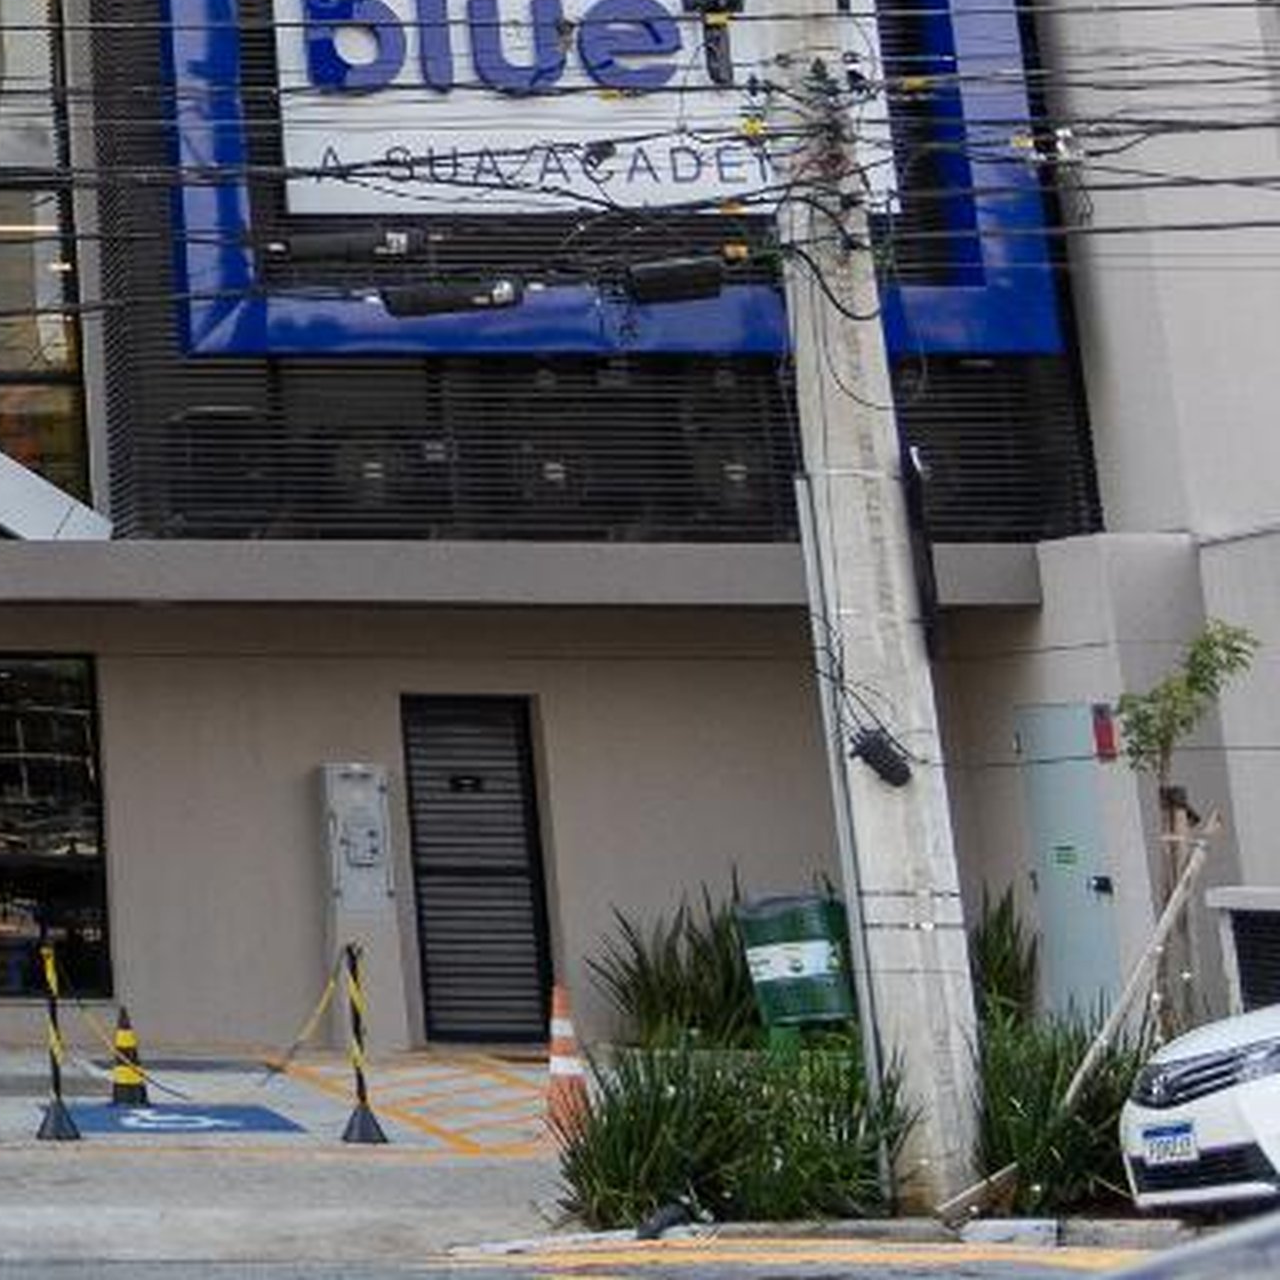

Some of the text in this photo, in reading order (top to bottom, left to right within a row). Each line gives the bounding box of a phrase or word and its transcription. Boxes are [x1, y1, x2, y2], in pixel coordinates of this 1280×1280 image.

[316, 144, 792, 187] A SUA ACADE
